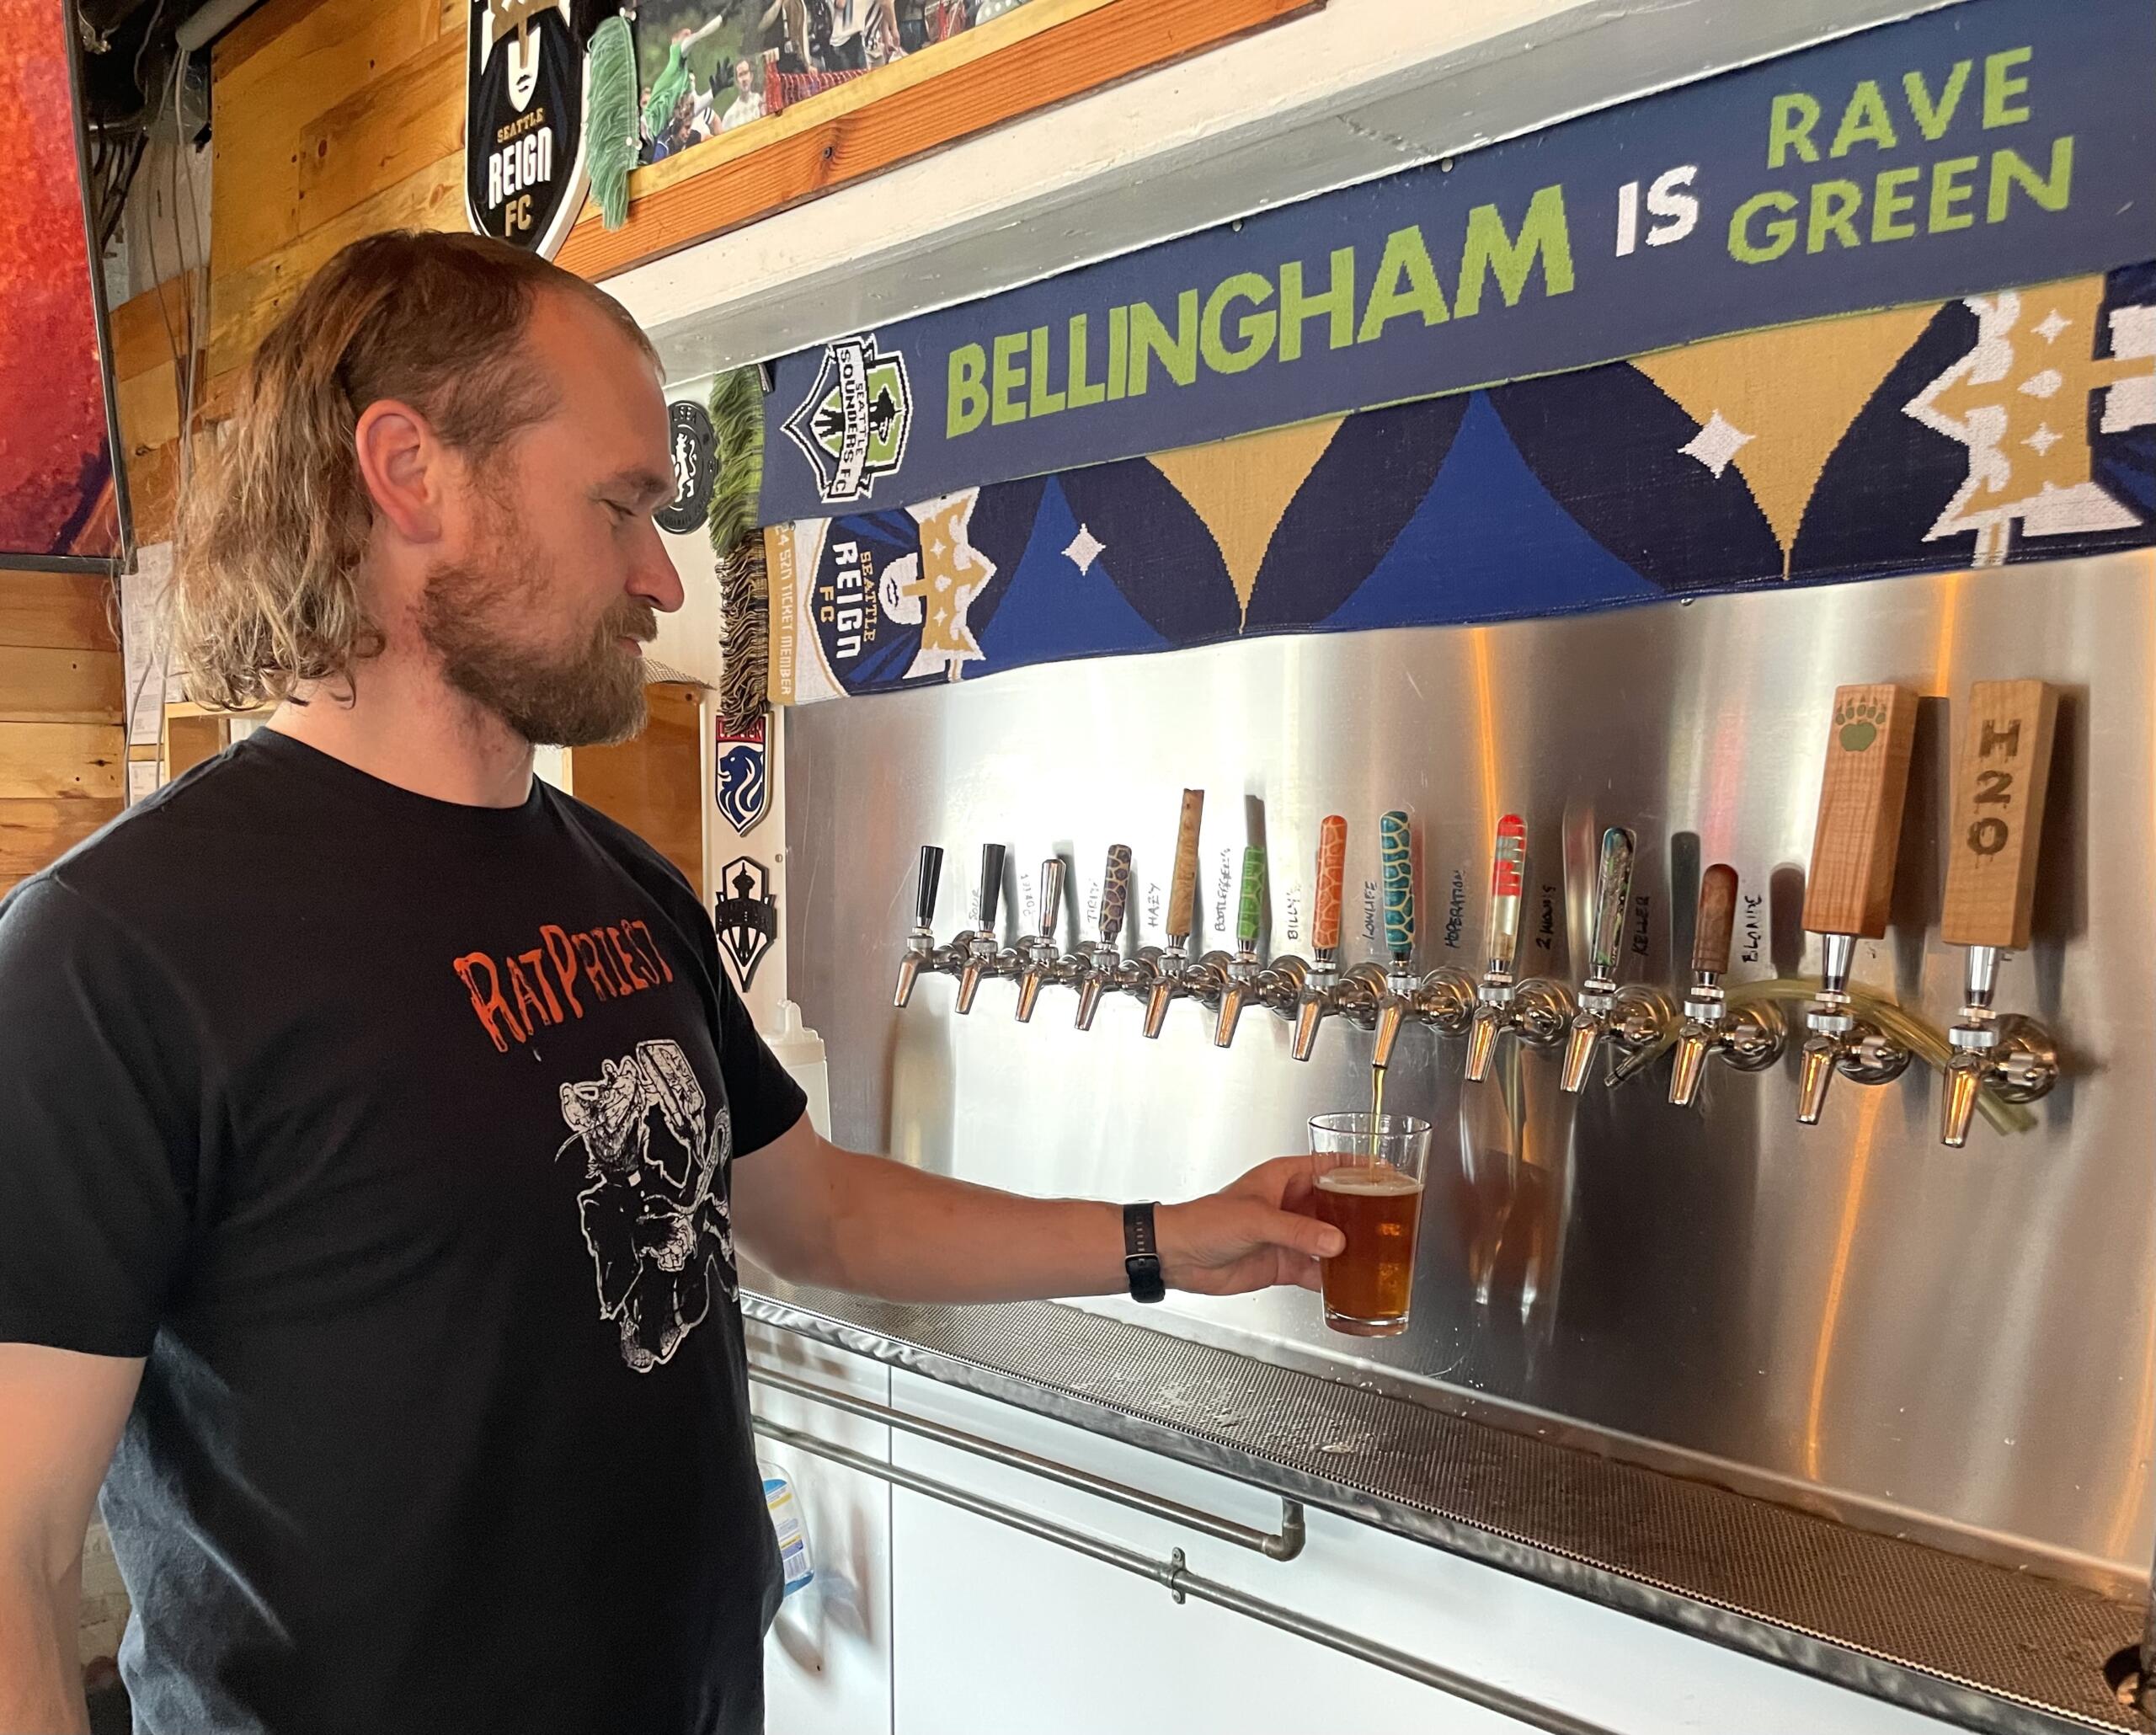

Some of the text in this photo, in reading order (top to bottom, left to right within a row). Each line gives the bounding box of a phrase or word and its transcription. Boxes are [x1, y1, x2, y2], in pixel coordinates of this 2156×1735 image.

[497, 107, 545, 143] SEATTLE
[1768, 45, 2033, 170] RAVE
[488, 126, 552, 210] REIGN
[505, 194, 532, 237] FC
[1727, 135, 2075, 265] GREEN
[946, 164, 1699, 440] BELLINGHAM IS
[835, 349, 857, 493] SOUNDERS FC
[855, 382, 867, 456] SEATTLE
[781, 583, 793, 630] TICKET
[819, 585, 835, 622] FC
[832, 541, 863, 659] REIGN
[860, 551, 878, 642] SEATTLE
[779, 636, 792, 696] MEMBER
[969, 889, 979, 921] SOUR
[1147, 883, 1161, 927] HAZY
[1362, 880, 1378, 941] LOWLIFE
[1631, 895, 1650, 957] KELLER
[1535, 937, 1551, 950] 2
